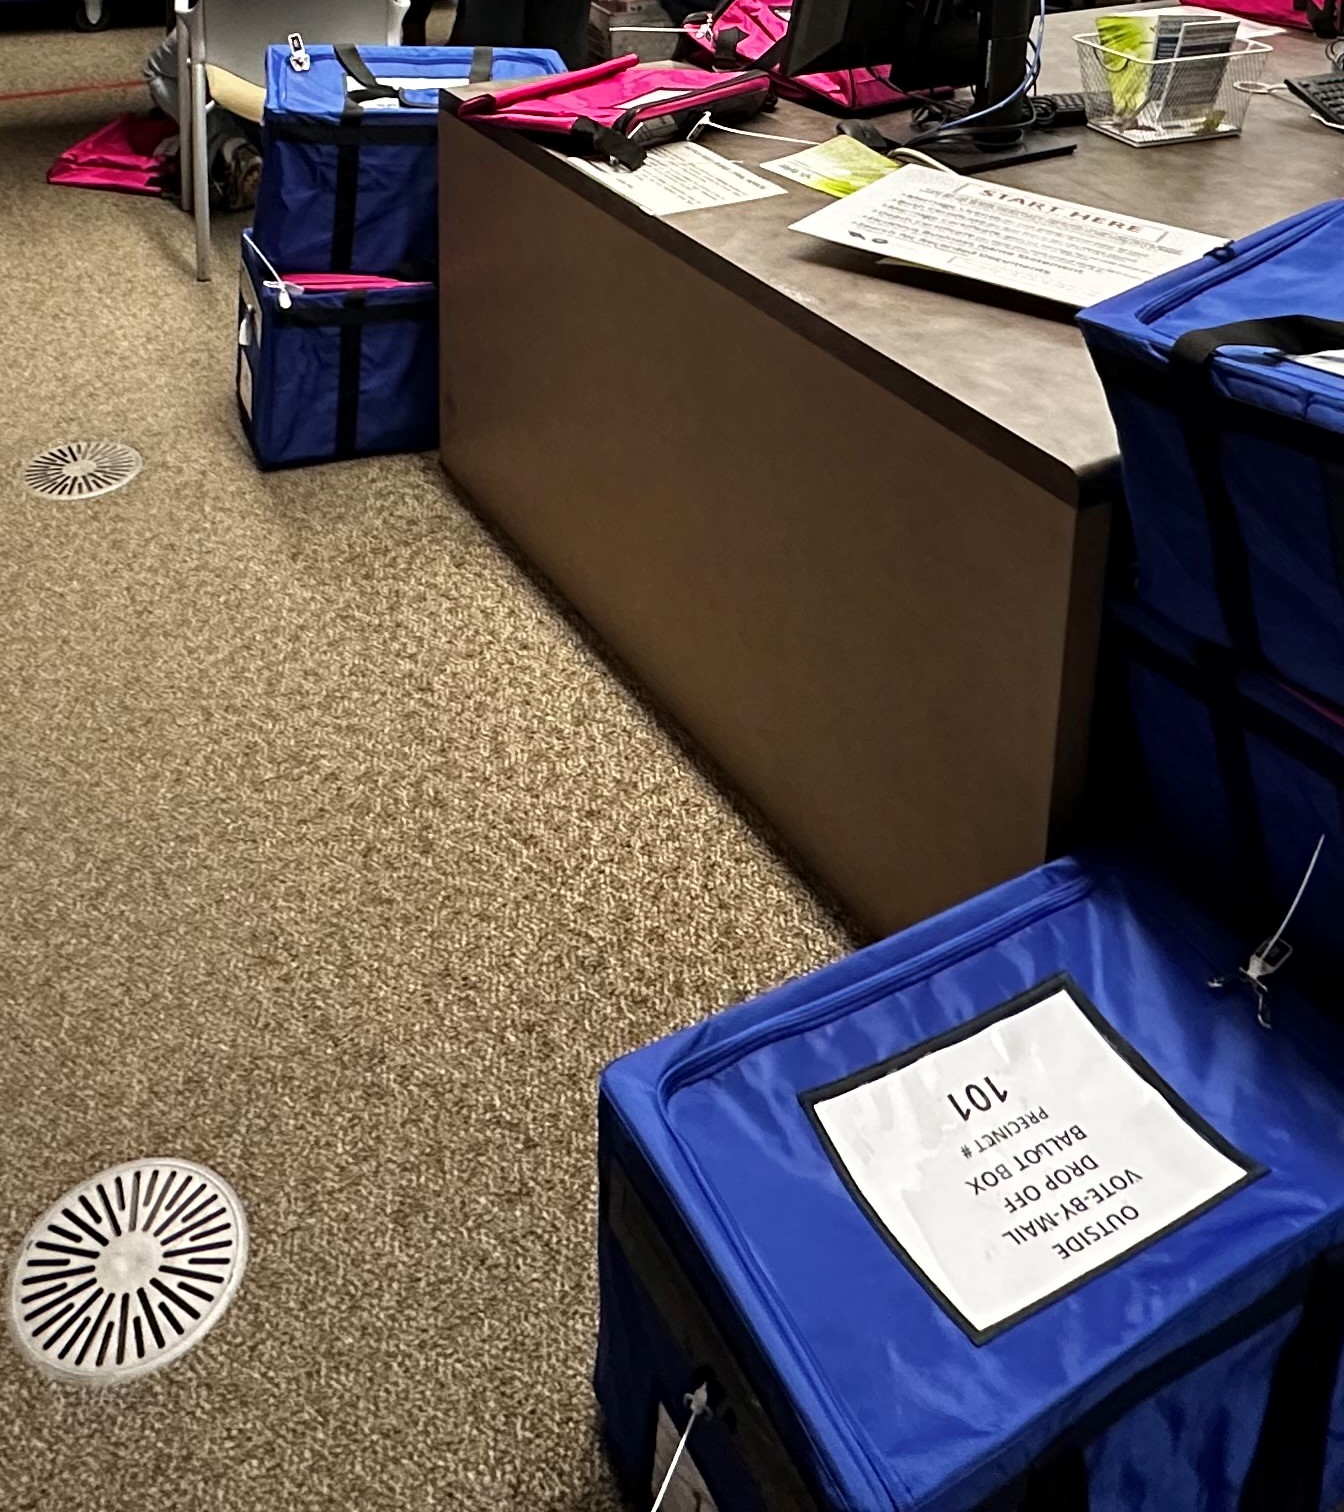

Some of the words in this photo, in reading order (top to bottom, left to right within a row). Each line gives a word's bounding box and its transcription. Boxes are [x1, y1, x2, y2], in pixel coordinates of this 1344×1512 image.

[981, 189, 1060, 214] START
[1069, 211, 1144, 234] HERE
[947, 1076, 1008, 1122] 101
[974, 1105, 1050, 1154] PRECINCT
[1013, 1124, 1088, 1172] BALLOT
[960, 1145, 973, 1160] #
[1045, 1154, 1100, 1191] DROP
[964, 1163, 1014, 1196] BOX
[1003, 1184, 1042, 1214] OFF
[1001, 1169, 1144, 1245] VOTE-BY-MAIL
[1051, 1204, 1140, 1260] OUTSIDE
